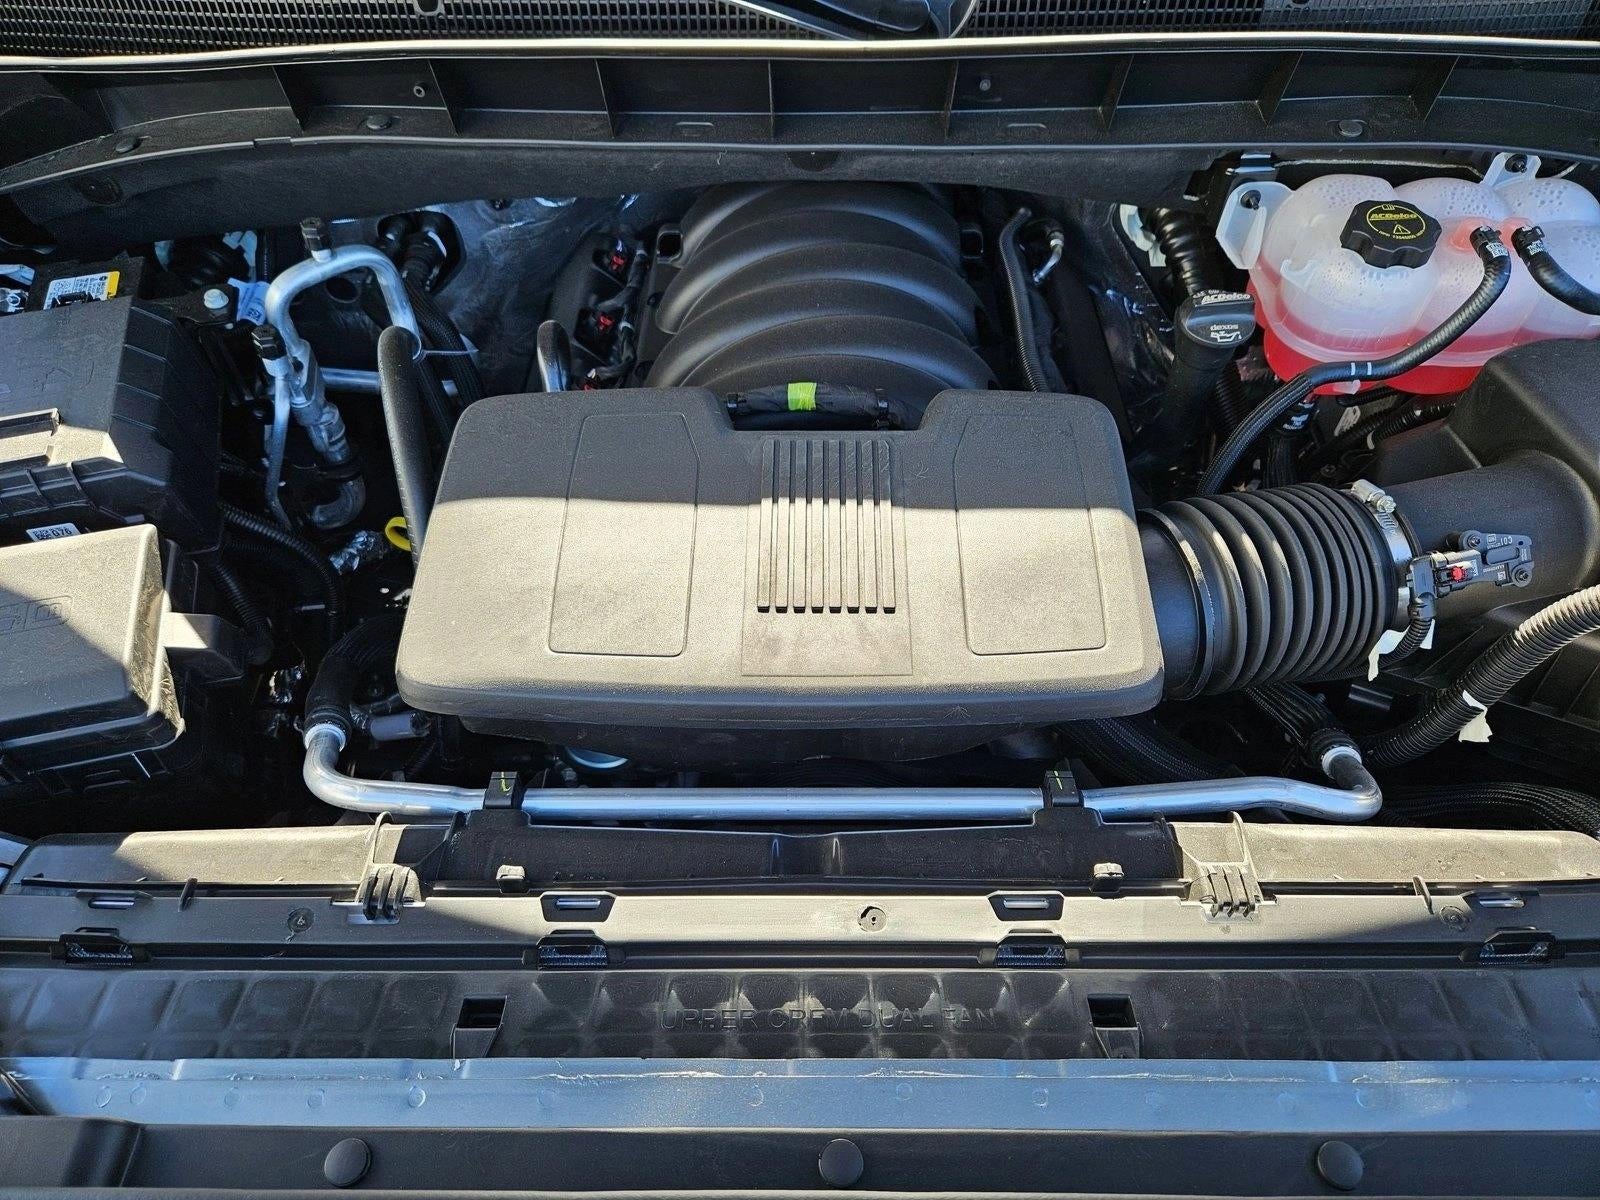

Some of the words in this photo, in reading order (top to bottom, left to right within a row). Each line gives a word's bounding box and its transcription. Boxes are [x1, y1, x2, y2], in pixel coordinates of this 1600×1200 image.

[1369, 212, 1418, 221] ACDelco
[1201, 292, 1251, 305] ACDelco
[660, 1007, 759, 1030] UPPER
[858, 1007, 934, 1029] DUAL
[941, 1007, 996, 1029] FAN
